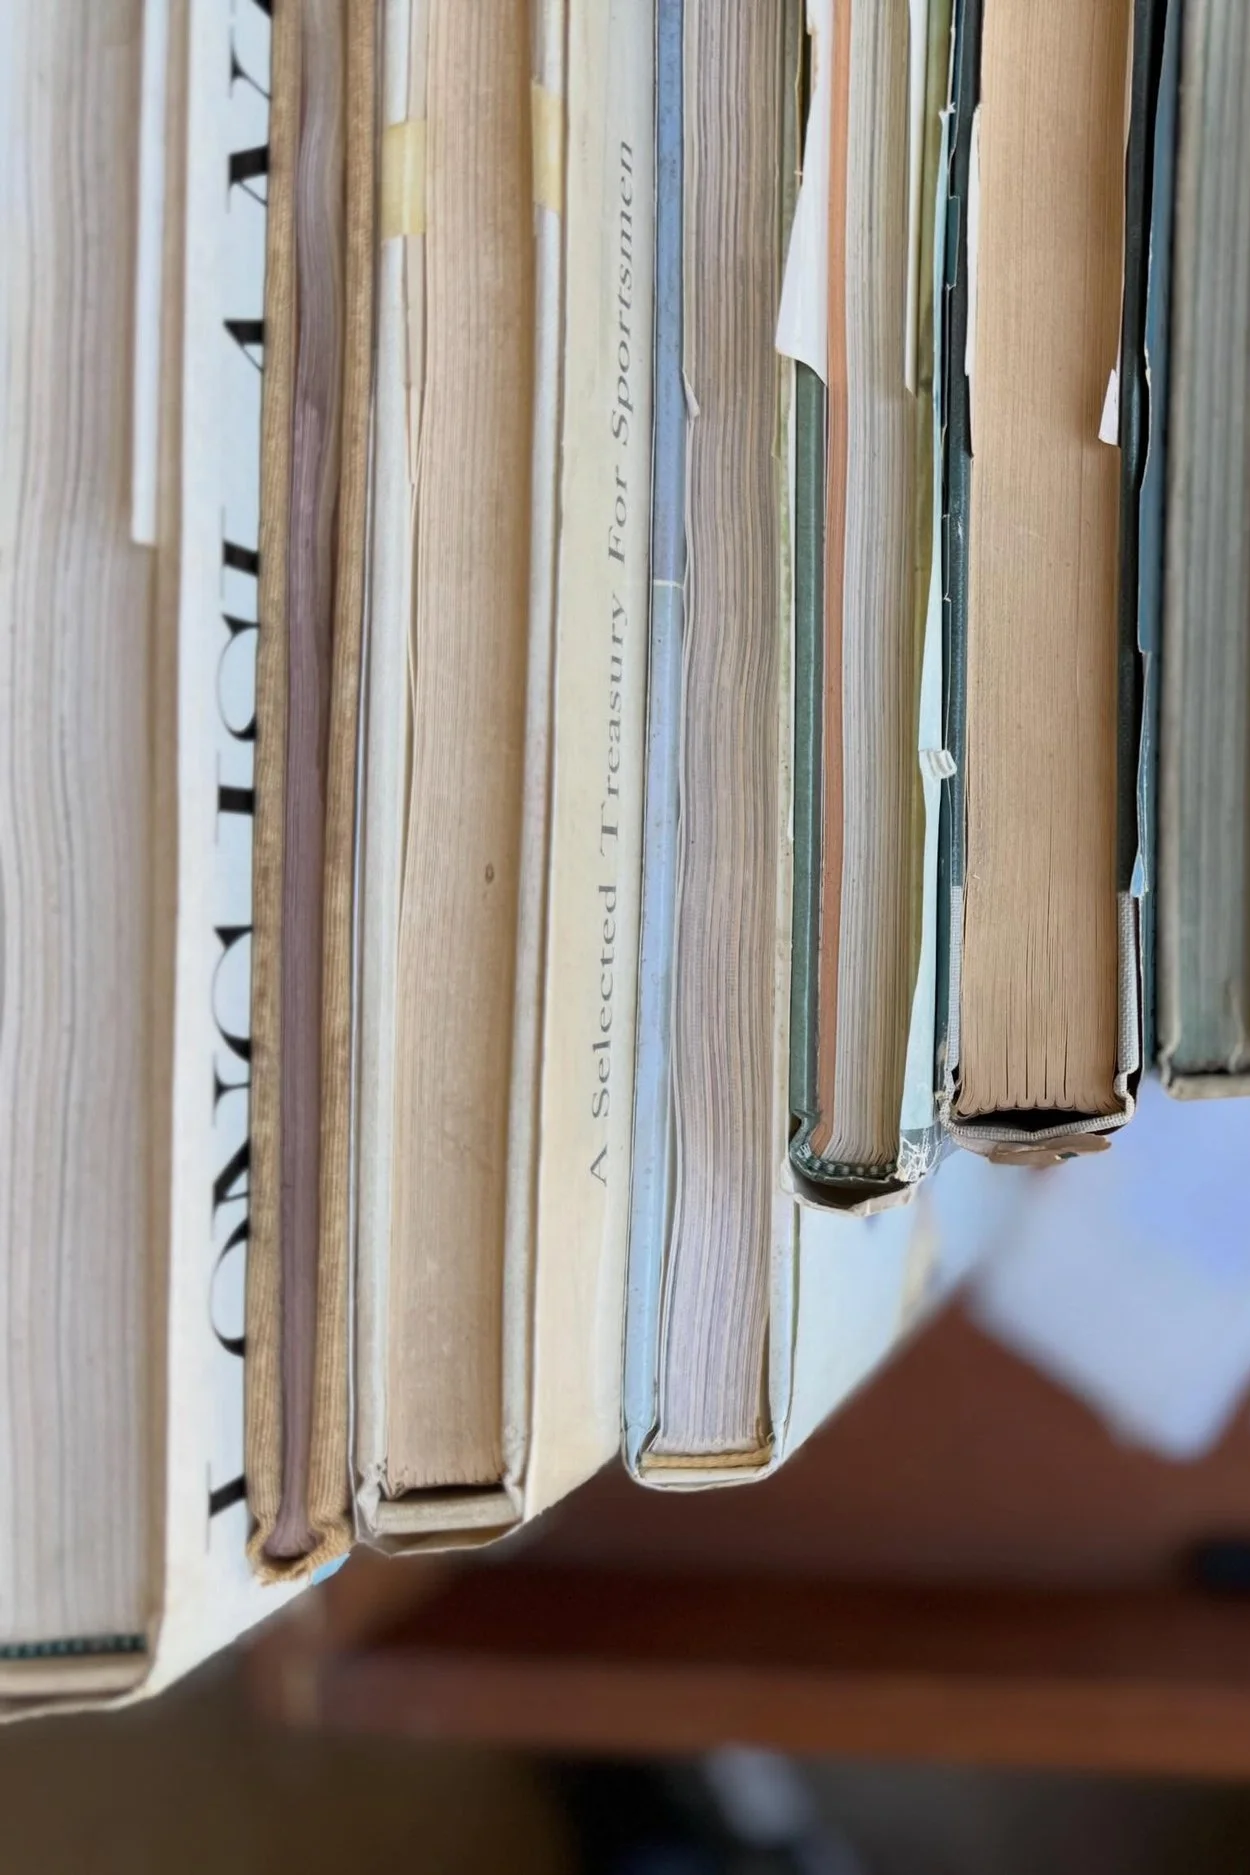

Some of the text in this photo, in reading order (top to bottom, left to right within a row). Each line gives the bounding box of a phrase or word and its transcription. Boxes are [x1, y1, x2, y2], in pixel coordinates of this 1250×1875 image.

[590, 140, 634, 1187] A Selected Treasury For Sportsmen
